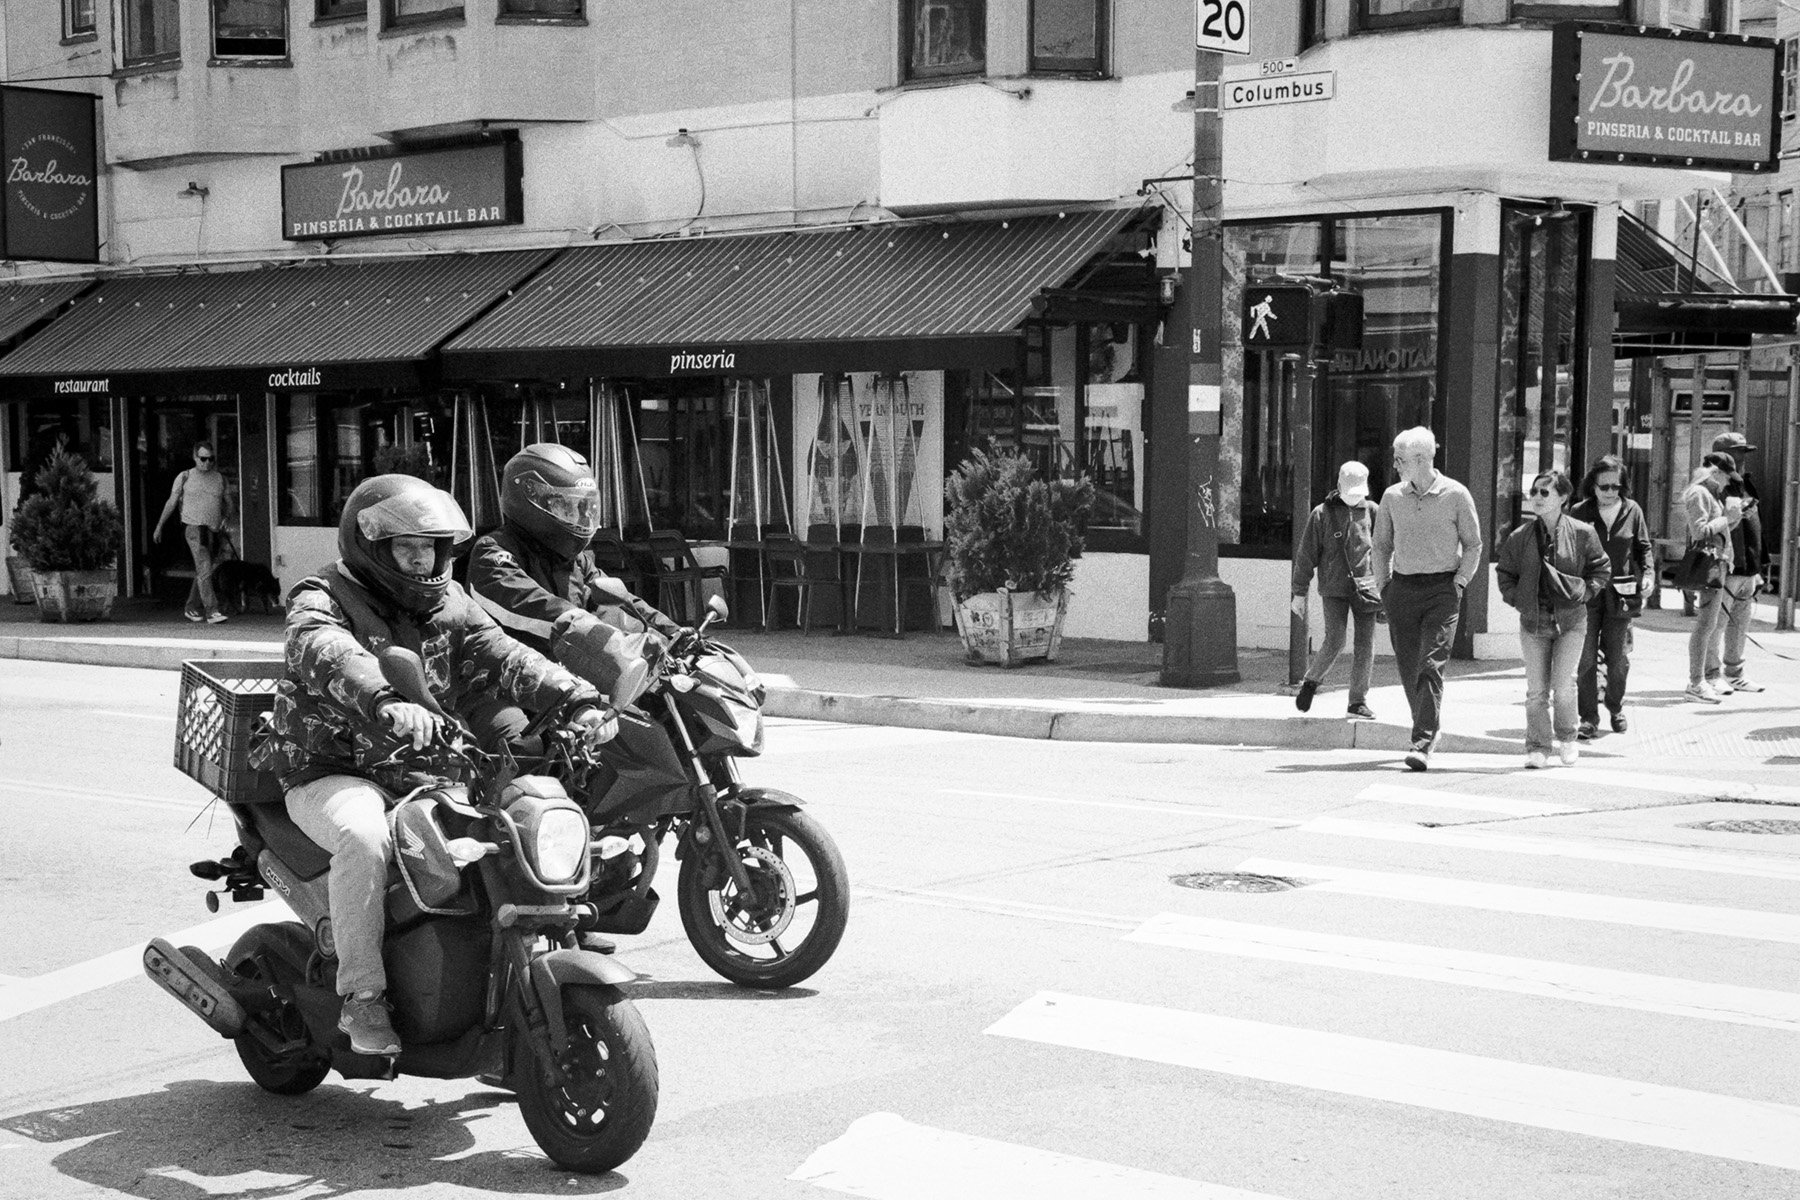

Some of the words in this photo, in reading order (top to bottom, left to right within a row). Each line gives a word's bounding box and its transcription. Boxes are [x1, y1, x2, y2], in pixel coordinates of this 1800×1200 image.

[1202, 0, 1245, 41] 20
[1262, 61, 1284, 74] 500
[1233, 81, 1324, 103] Columbus
[1588, 51, 1763, 118] Barbara
[1587, 121, 1650, 139] PINSERIA
[1654, 126, 1665, 140] &
[1667, 127, 1731, 145] COCKTAIL
[1734, 131, 1762, 147] BAR
[6, 156, 92, 186] Barbara
[335, 161, 450, 220] Barbara
[293, 218, 364, 236] PINSERIA
[369, 216, 379, 229] &
[384, 209, 462, 228] COCKTAIL
[467, 206, 501, 222] BAR
[670, 348, 735, 374] pinseria
[54, 378, 110, 393] restaurant
[268, 367, 321, 387] cocktails
